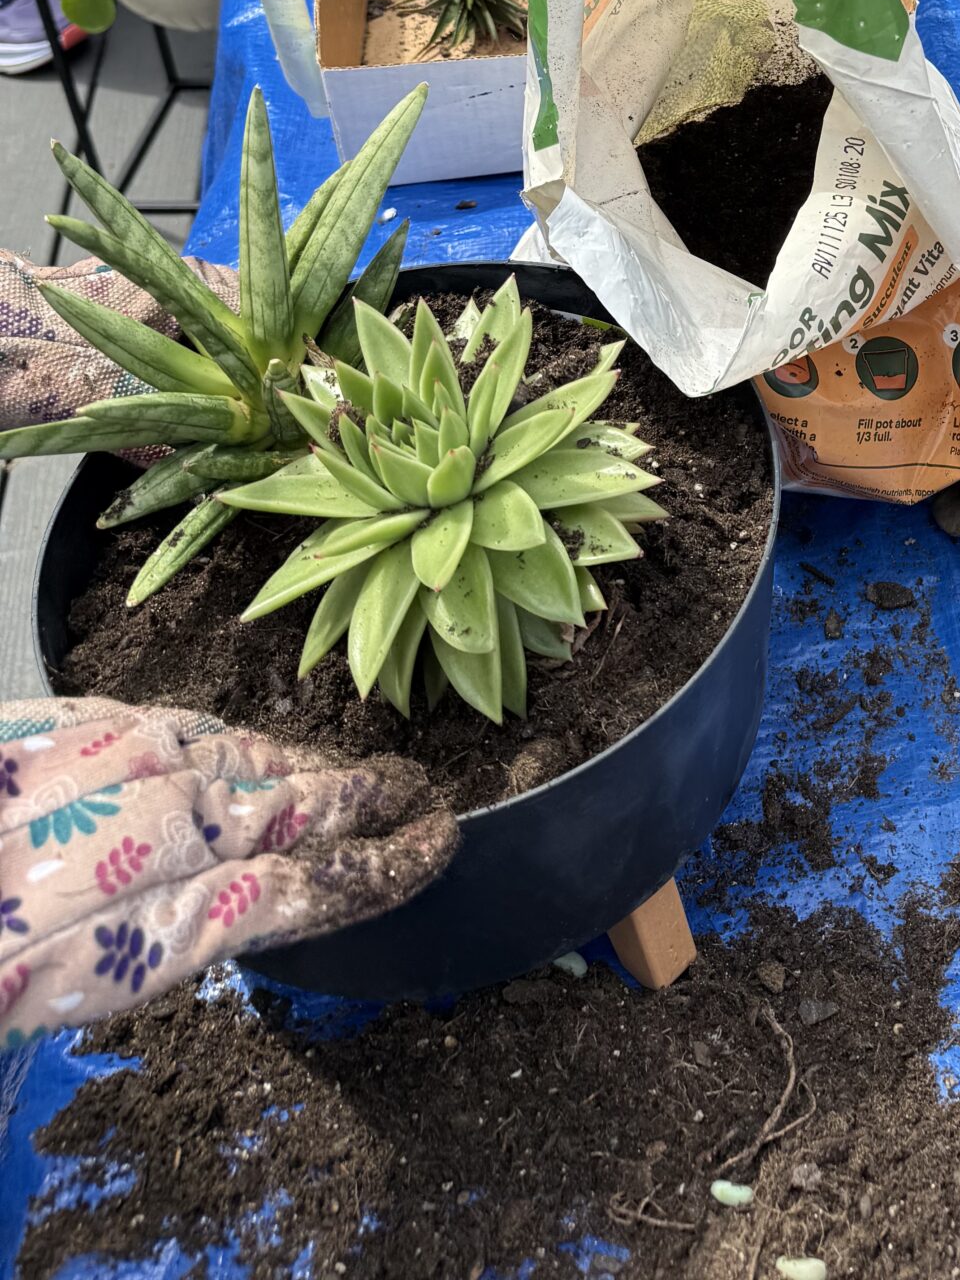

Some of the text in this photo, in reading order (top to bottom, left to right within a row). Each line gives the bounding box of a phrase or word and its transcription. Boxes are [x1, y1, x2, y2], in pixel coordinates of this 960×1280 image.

[832, 193, 853, 208] L3
[857, 180, 911, 264] Mix
[913, 240, 945, 278] Vita
[862, 240, 912, 329] Succulent
[950, 330, 959, 342] 3
[849, 338, 859, 350] 2
[770, 412, 799, 428] elect
[857, 417, 922, 432] Fill pot about
[856, 430, 892, 445] 1/3 full.
